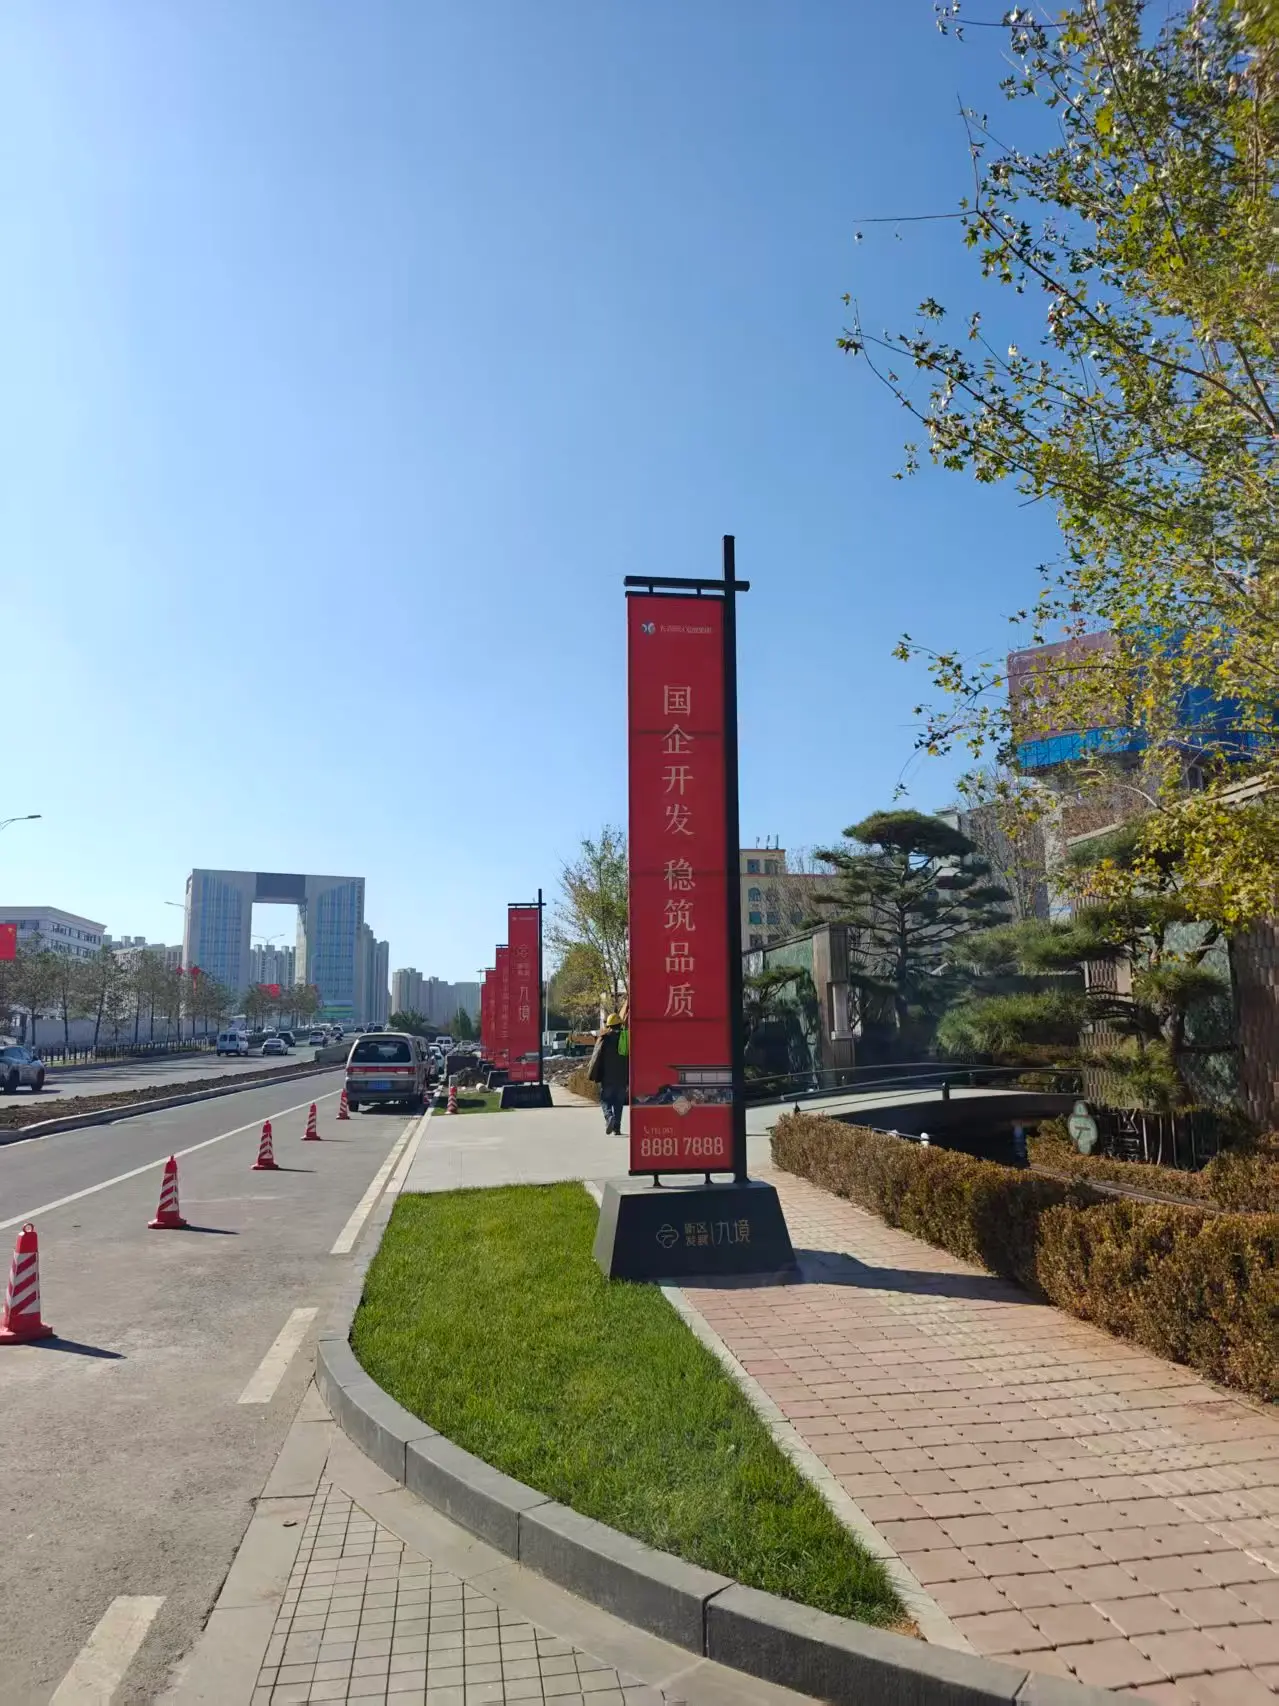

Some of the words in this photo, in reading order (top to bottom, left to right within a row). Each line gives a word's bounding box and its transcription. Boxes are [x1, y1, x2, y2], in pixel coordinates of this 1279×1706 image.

[661, 684, 695, 836] 国企开发
[663, 857, 696, 1018] 稳筑品质
[641, 1137, 679, 1157] 8881
[683, 1136, 724, 1156] 7888
